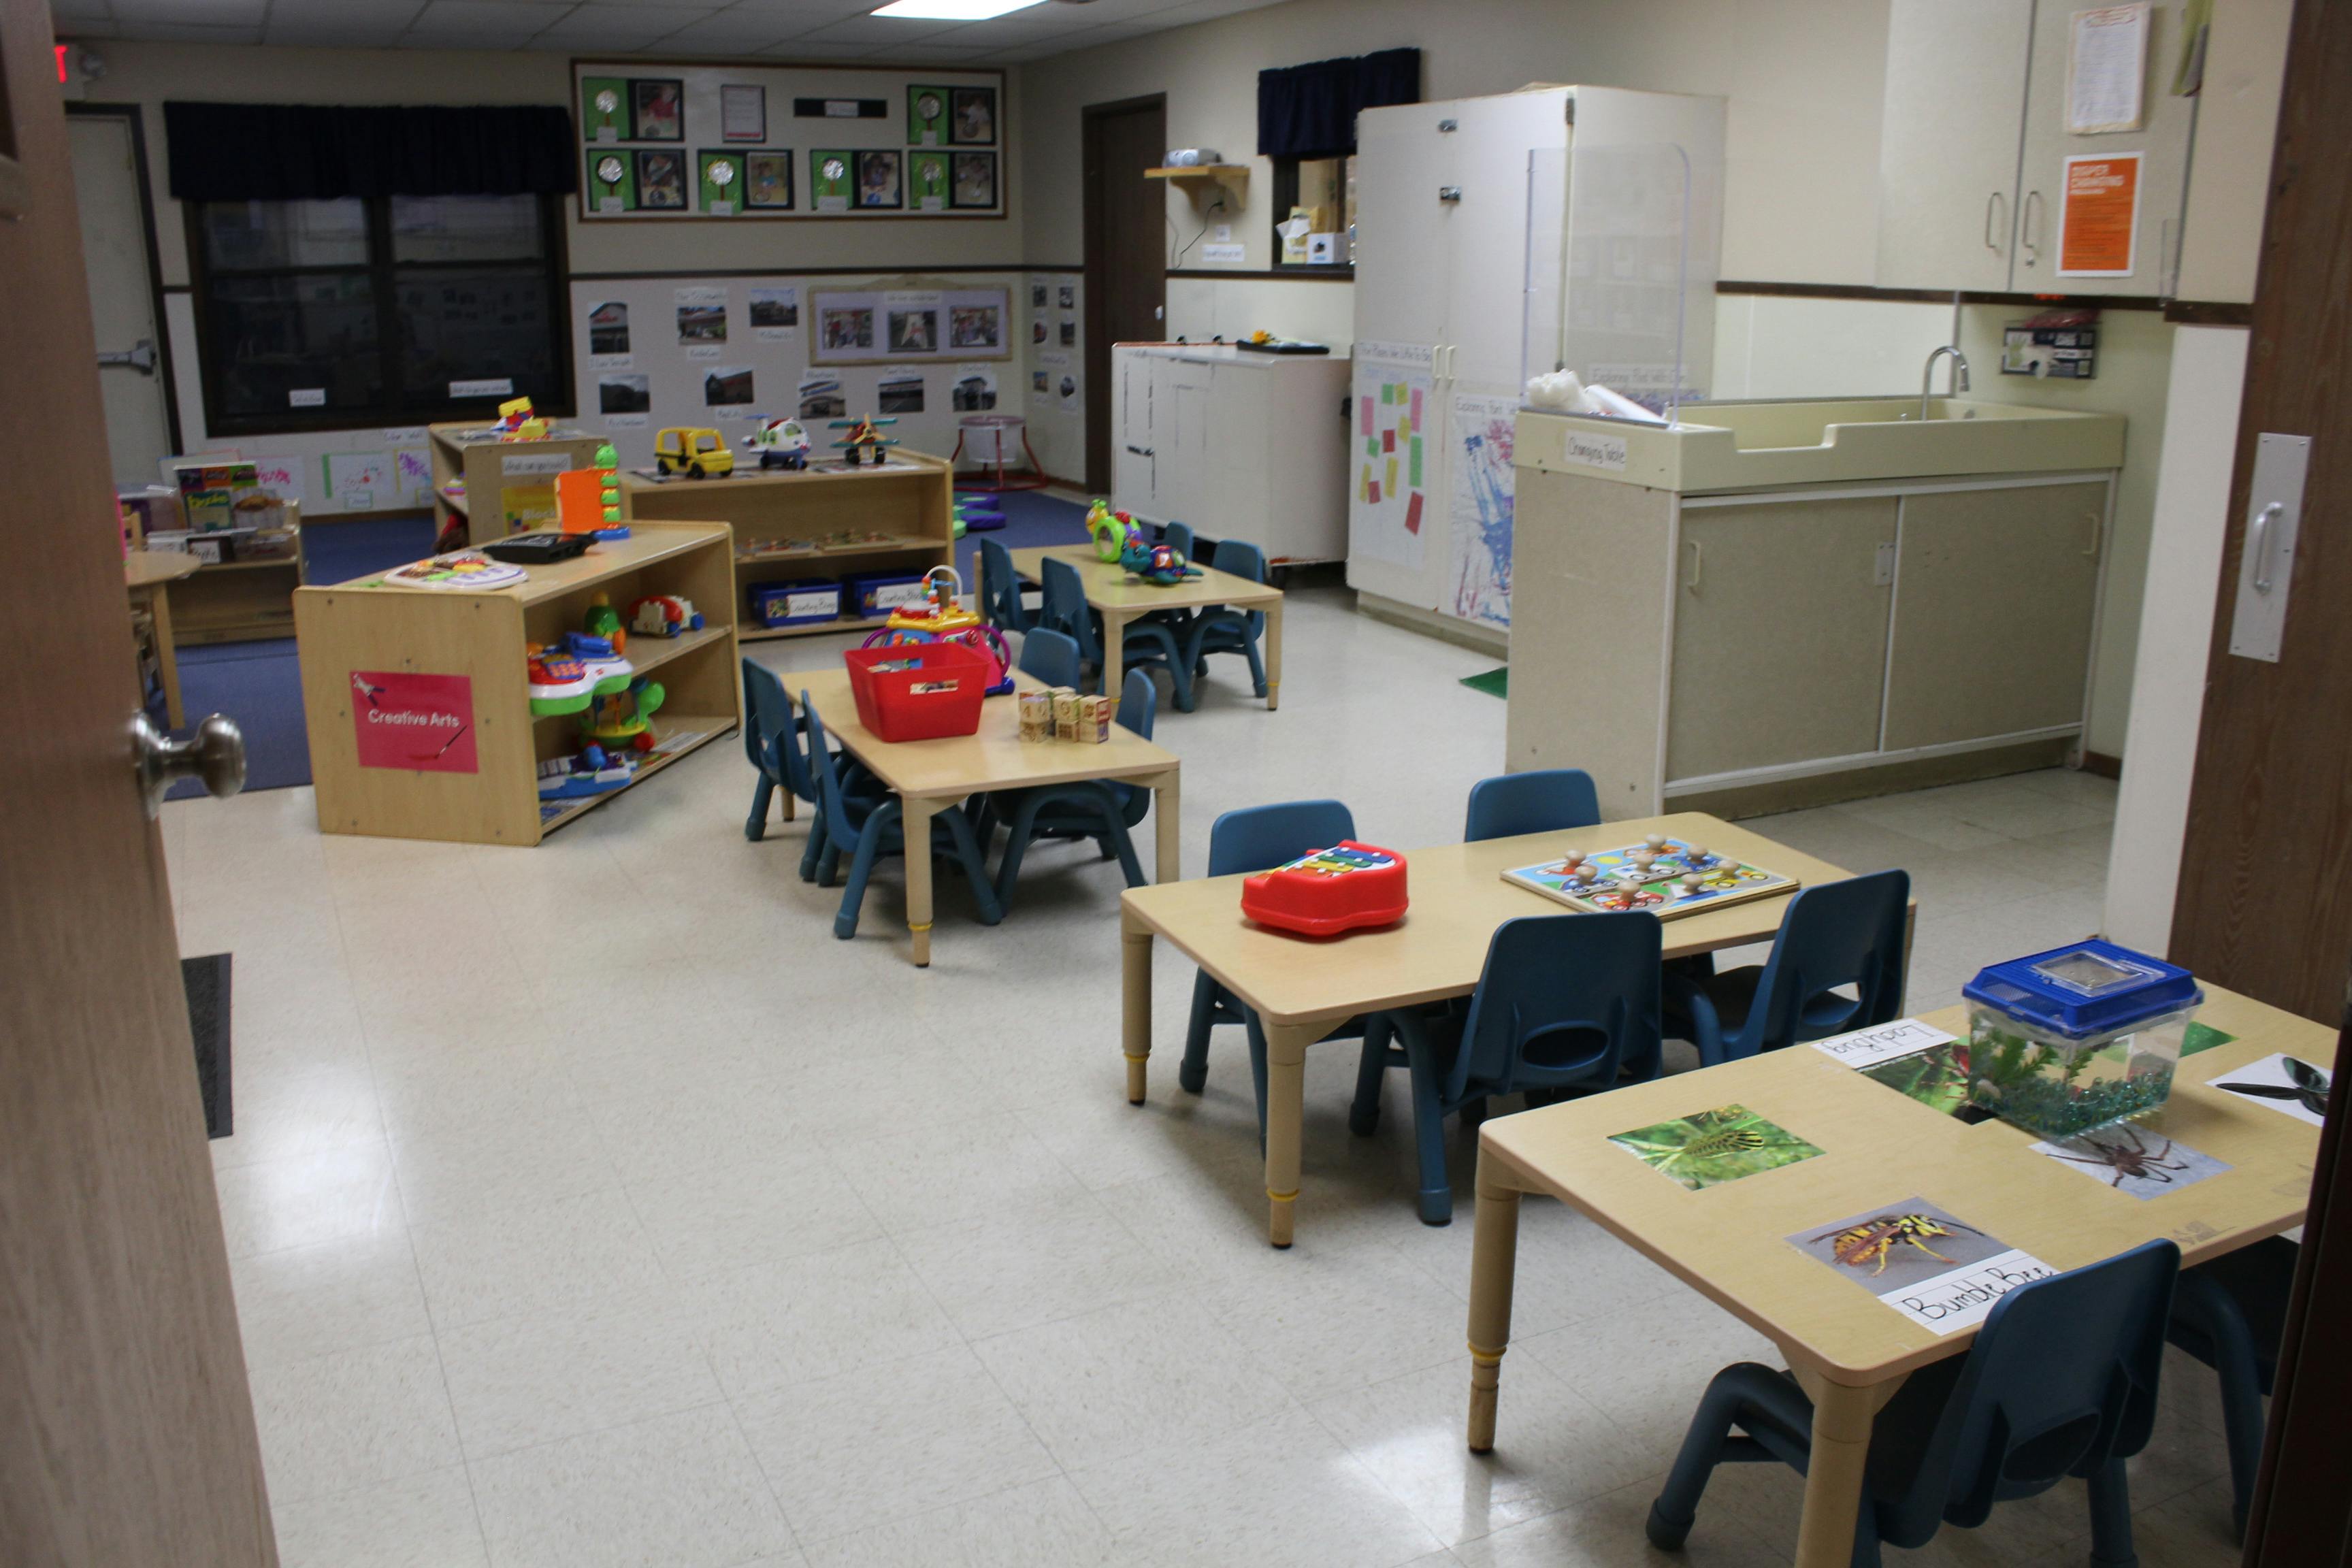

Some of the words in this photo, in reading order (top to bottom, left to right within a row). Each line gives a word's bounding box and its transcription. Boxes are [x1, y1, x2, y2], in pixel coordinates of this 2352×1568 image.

[1567, 436, 1603, 464] Changing
[1603, 442, 1625, 464] Table
[368, 708, 427, 725] Creative
[429, 712, 460, 728] Arts
[1901, 1279, 2007, 1320] Bumble
[1984, 1267, 2053, 1286] Bee
